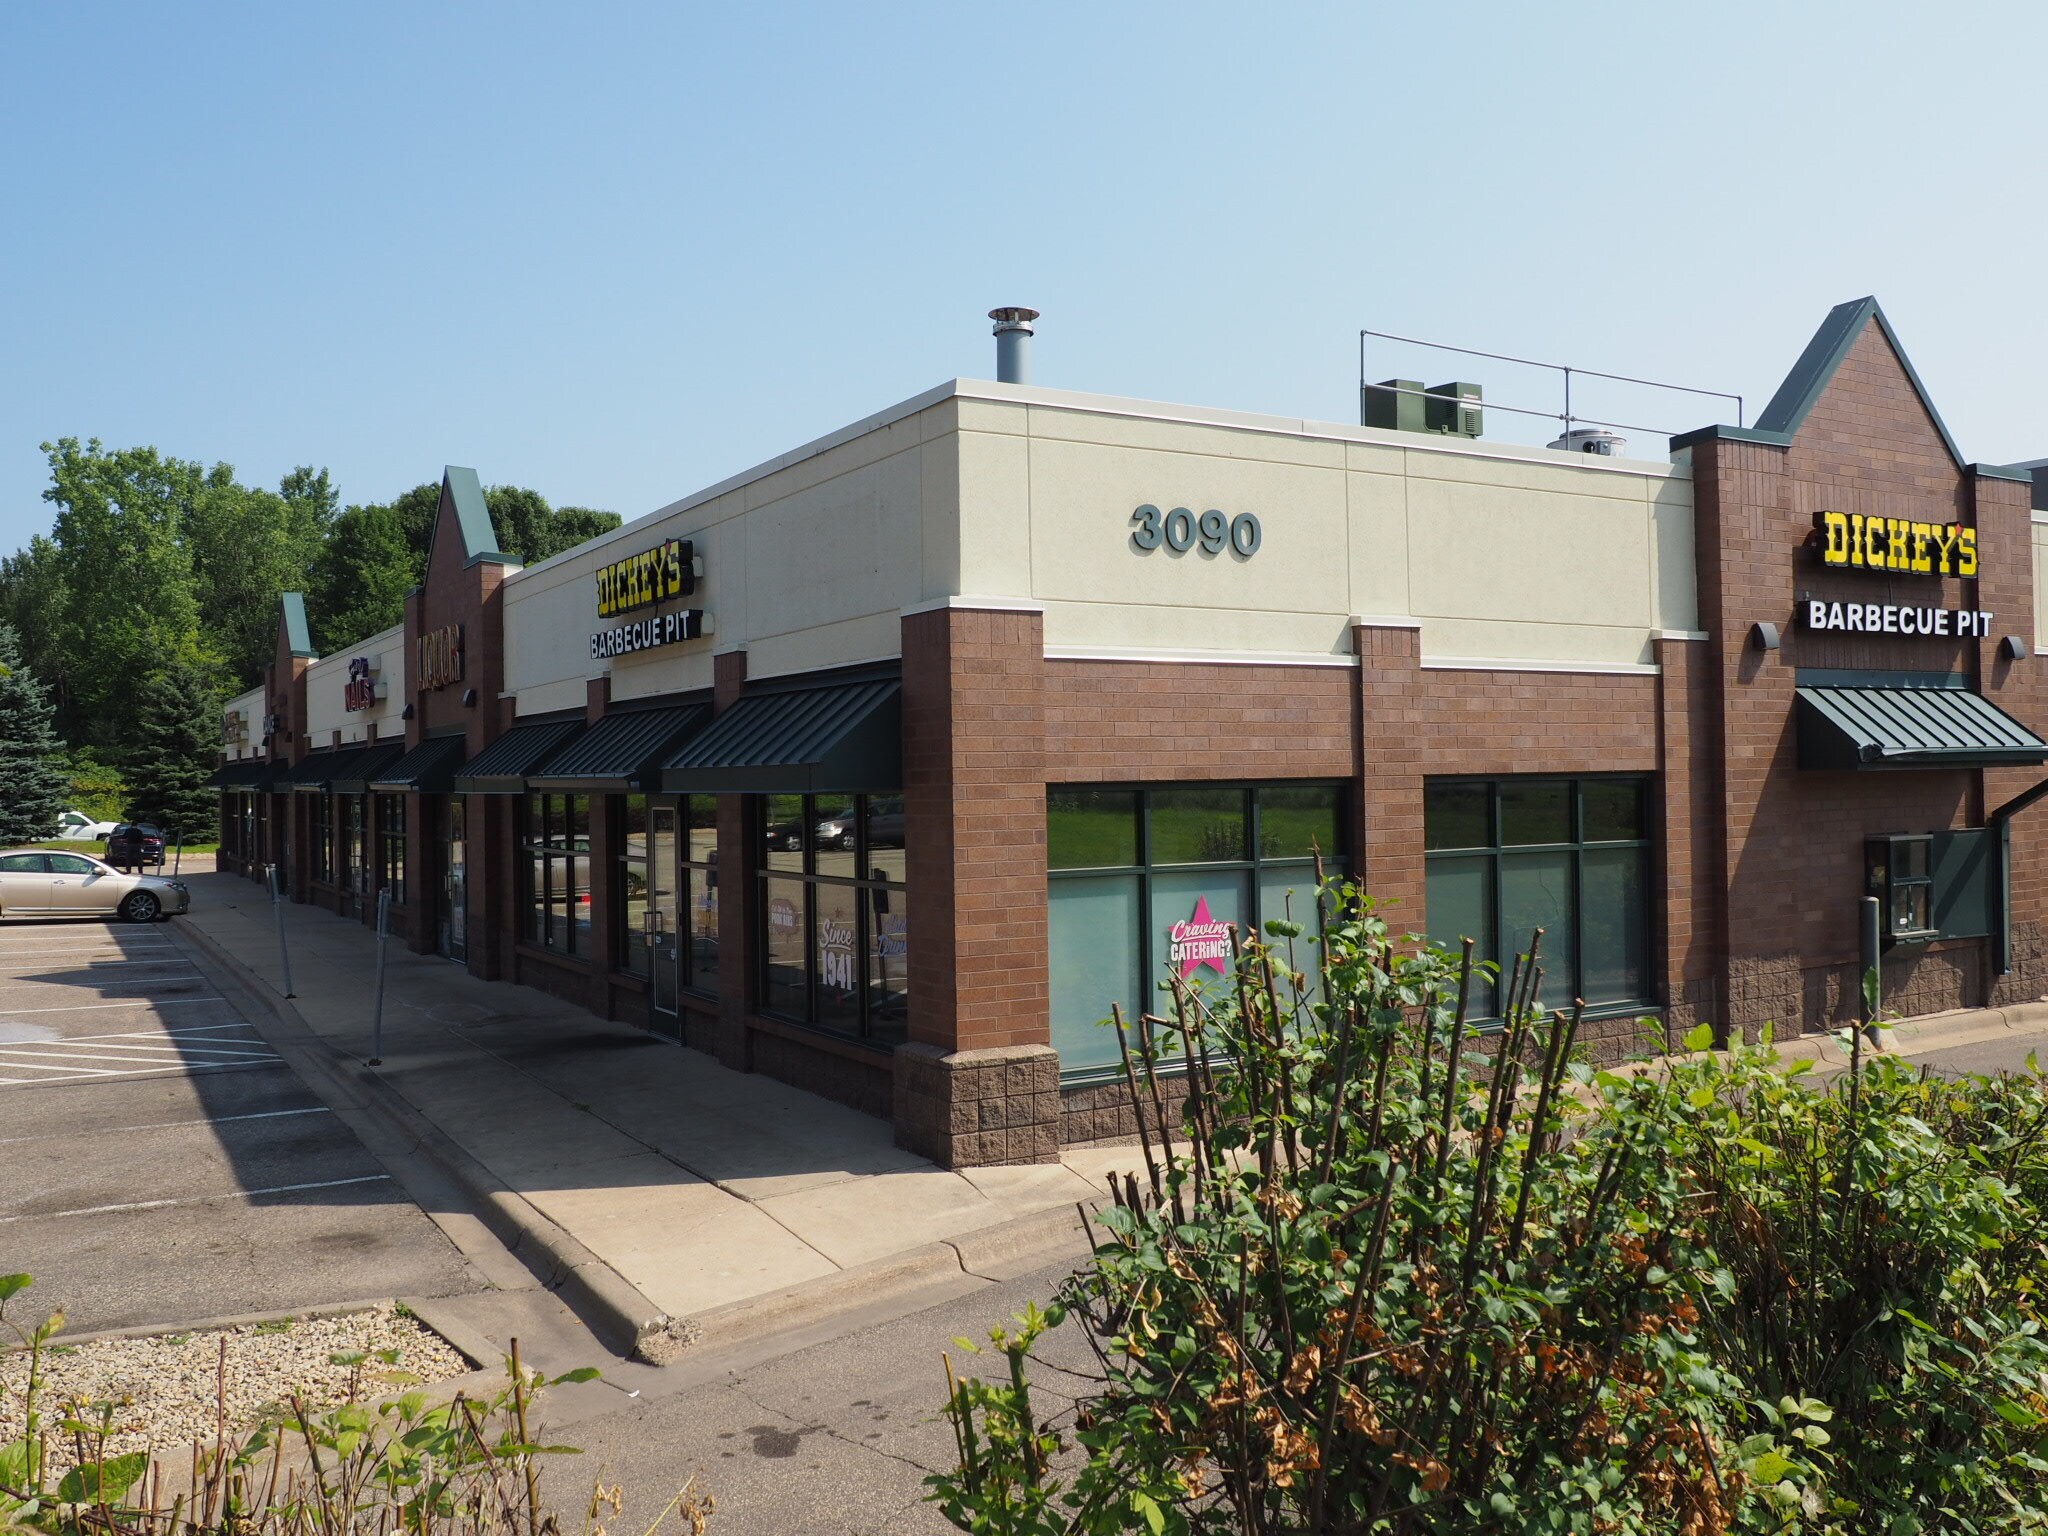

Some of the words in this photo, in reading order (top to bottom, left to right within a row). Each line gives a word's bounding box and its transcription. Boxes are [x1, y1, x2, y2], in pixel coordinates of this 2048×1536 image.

[1132, 503, 1262, 556] 3090
[1824, 511, 1979, 576] DICKEY'S
[597, 540, 681, 615] DICKEY'S
[590, 617, 661, 659] BARBECUE
[666, 609, 690, 643] PIT
[1809, 600, 1949, 636] BARBECUE
[1957, 610, 1994, 637] PIT
[416, 623, 461, 691] LIQUOR
[344, 679, 371, 712] NAILS
[820, 918, 852, 948] Since
[1170, 919, 1231, 943] Craving
[822, 949, 852, 990] 1941
